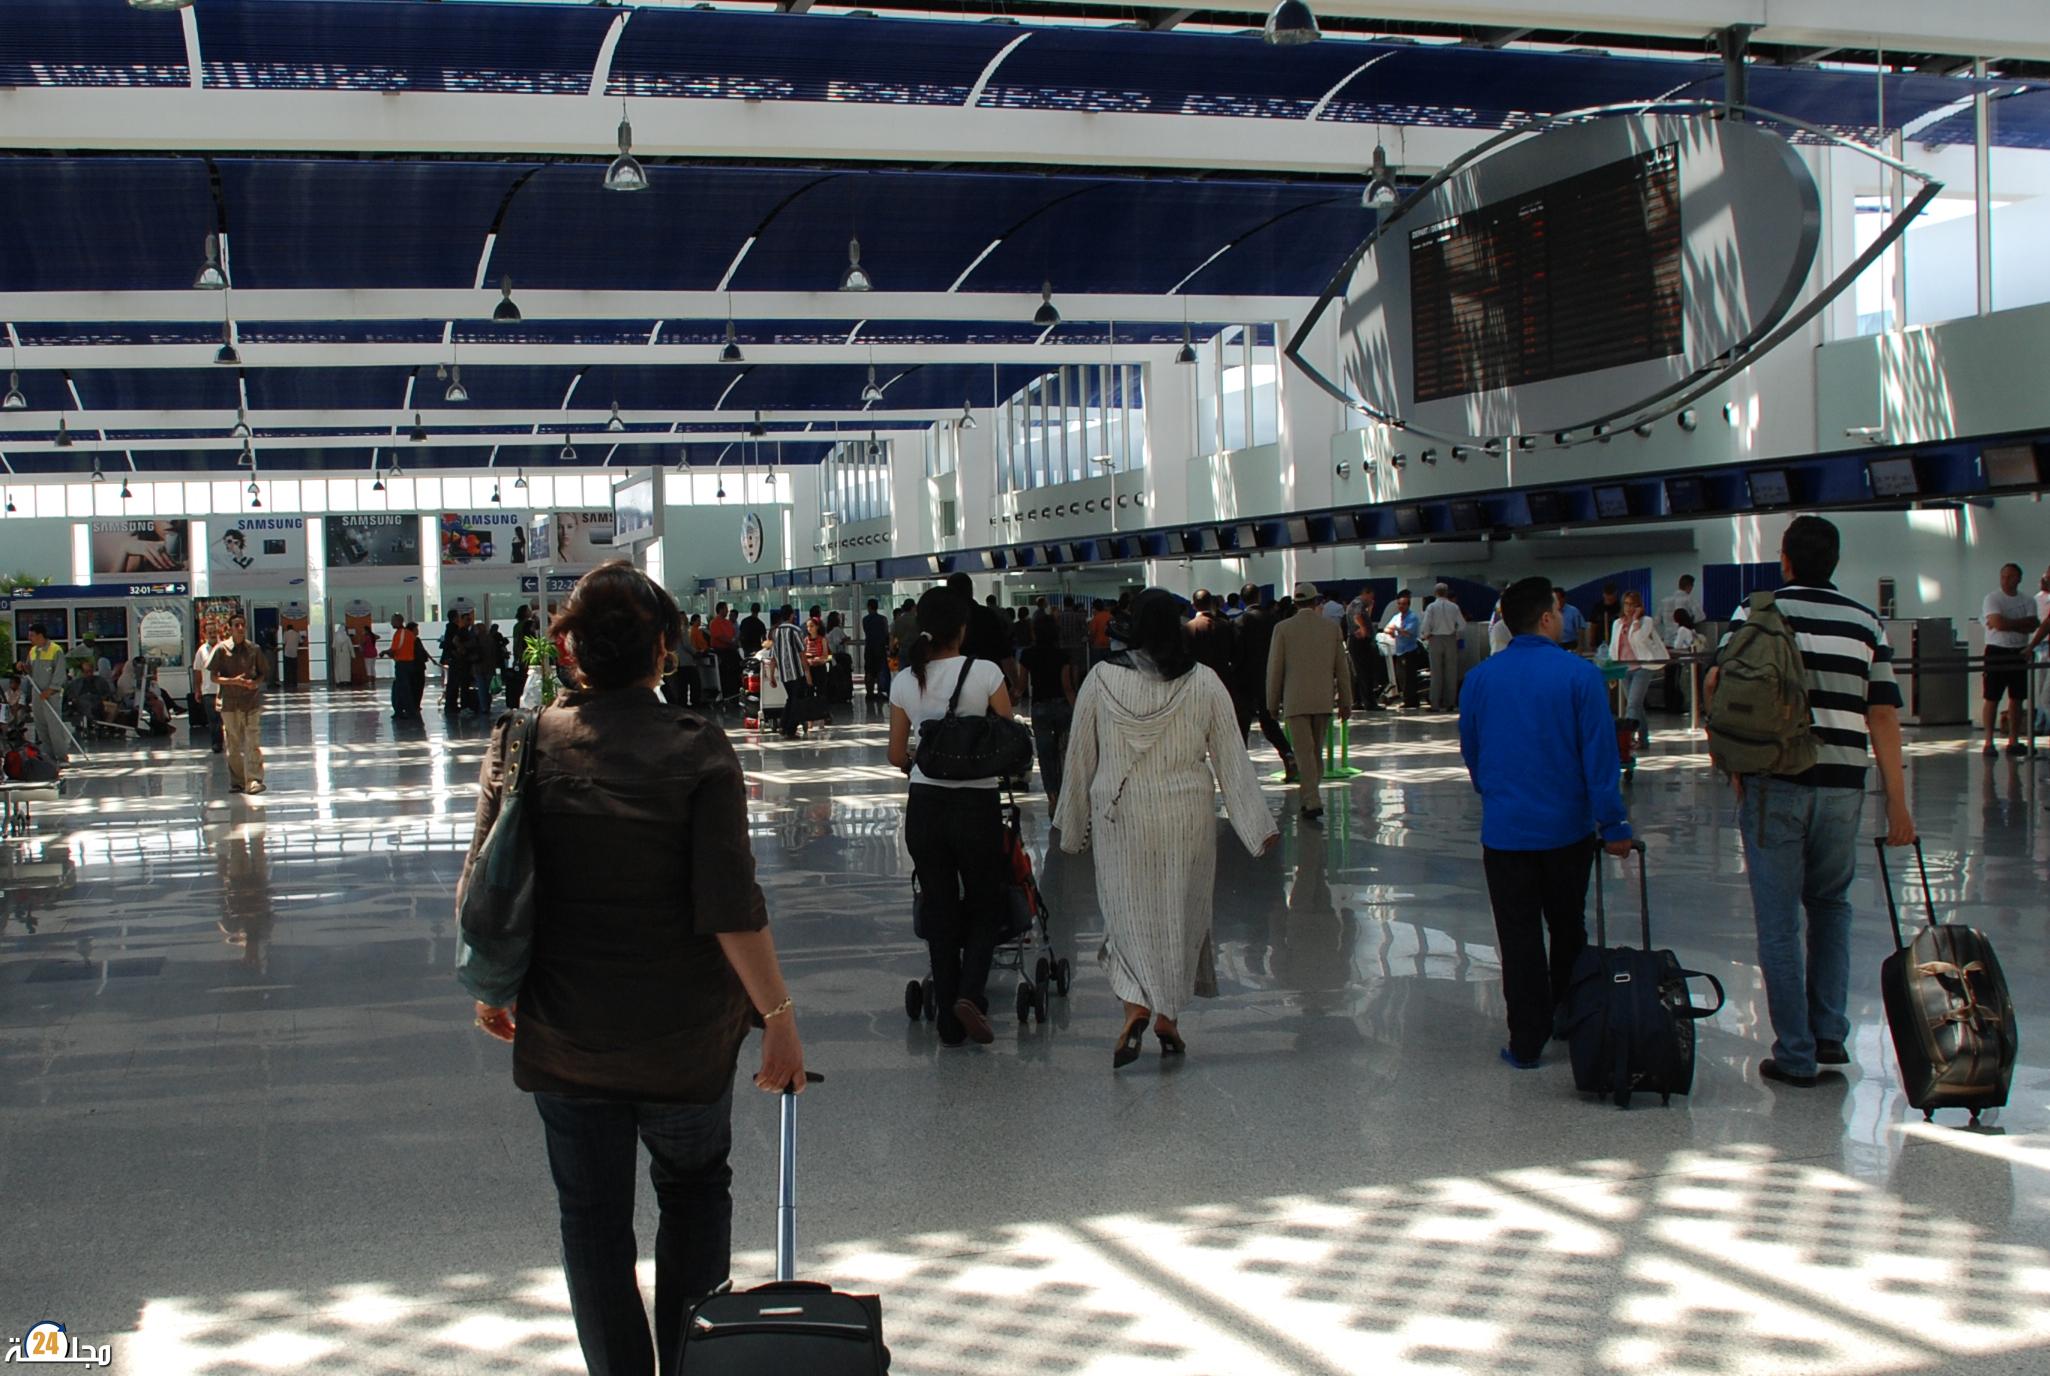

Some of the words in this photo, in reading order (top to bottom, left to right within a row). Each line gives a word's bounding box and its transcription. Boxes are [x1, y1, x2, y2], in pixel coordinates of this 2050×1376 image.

[238, 518, 303, 530] SAMSUNG
[342, 515, 402, 526] SAMSUNG
[93, 521, 155, 532] SAMSUNG
